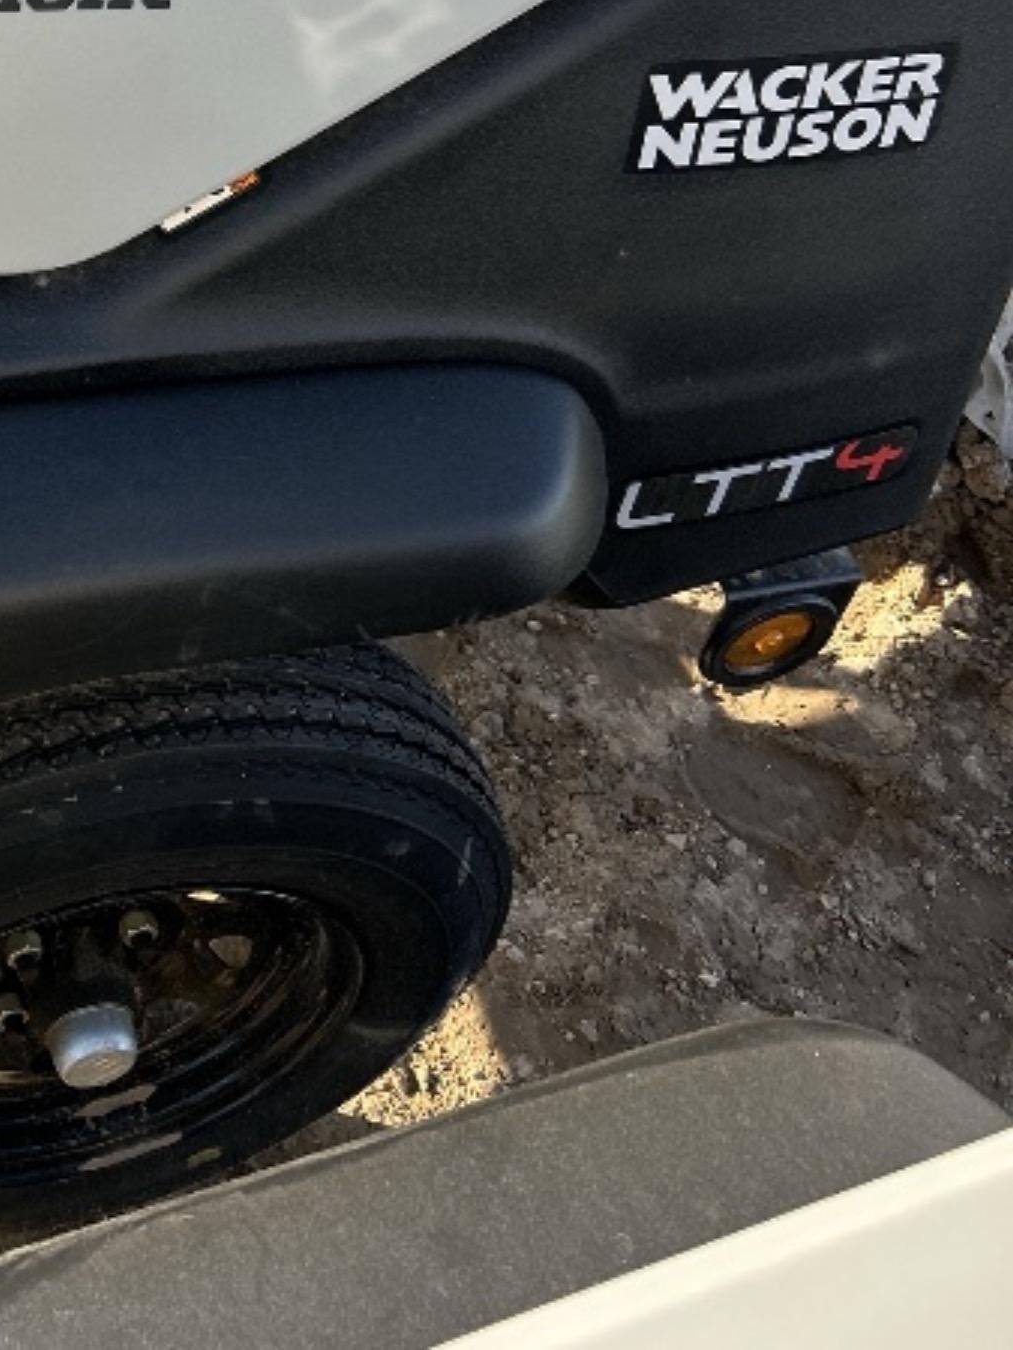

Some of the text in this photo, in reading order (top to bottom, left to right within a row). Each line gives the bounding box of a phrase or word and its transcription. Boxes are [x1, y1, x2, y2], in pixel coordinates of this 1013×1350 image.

[648, 52, 945, 121] WACKER
[637, 98, 938, 170] NEUSON
[616, 440, 903, 530] LTT4
